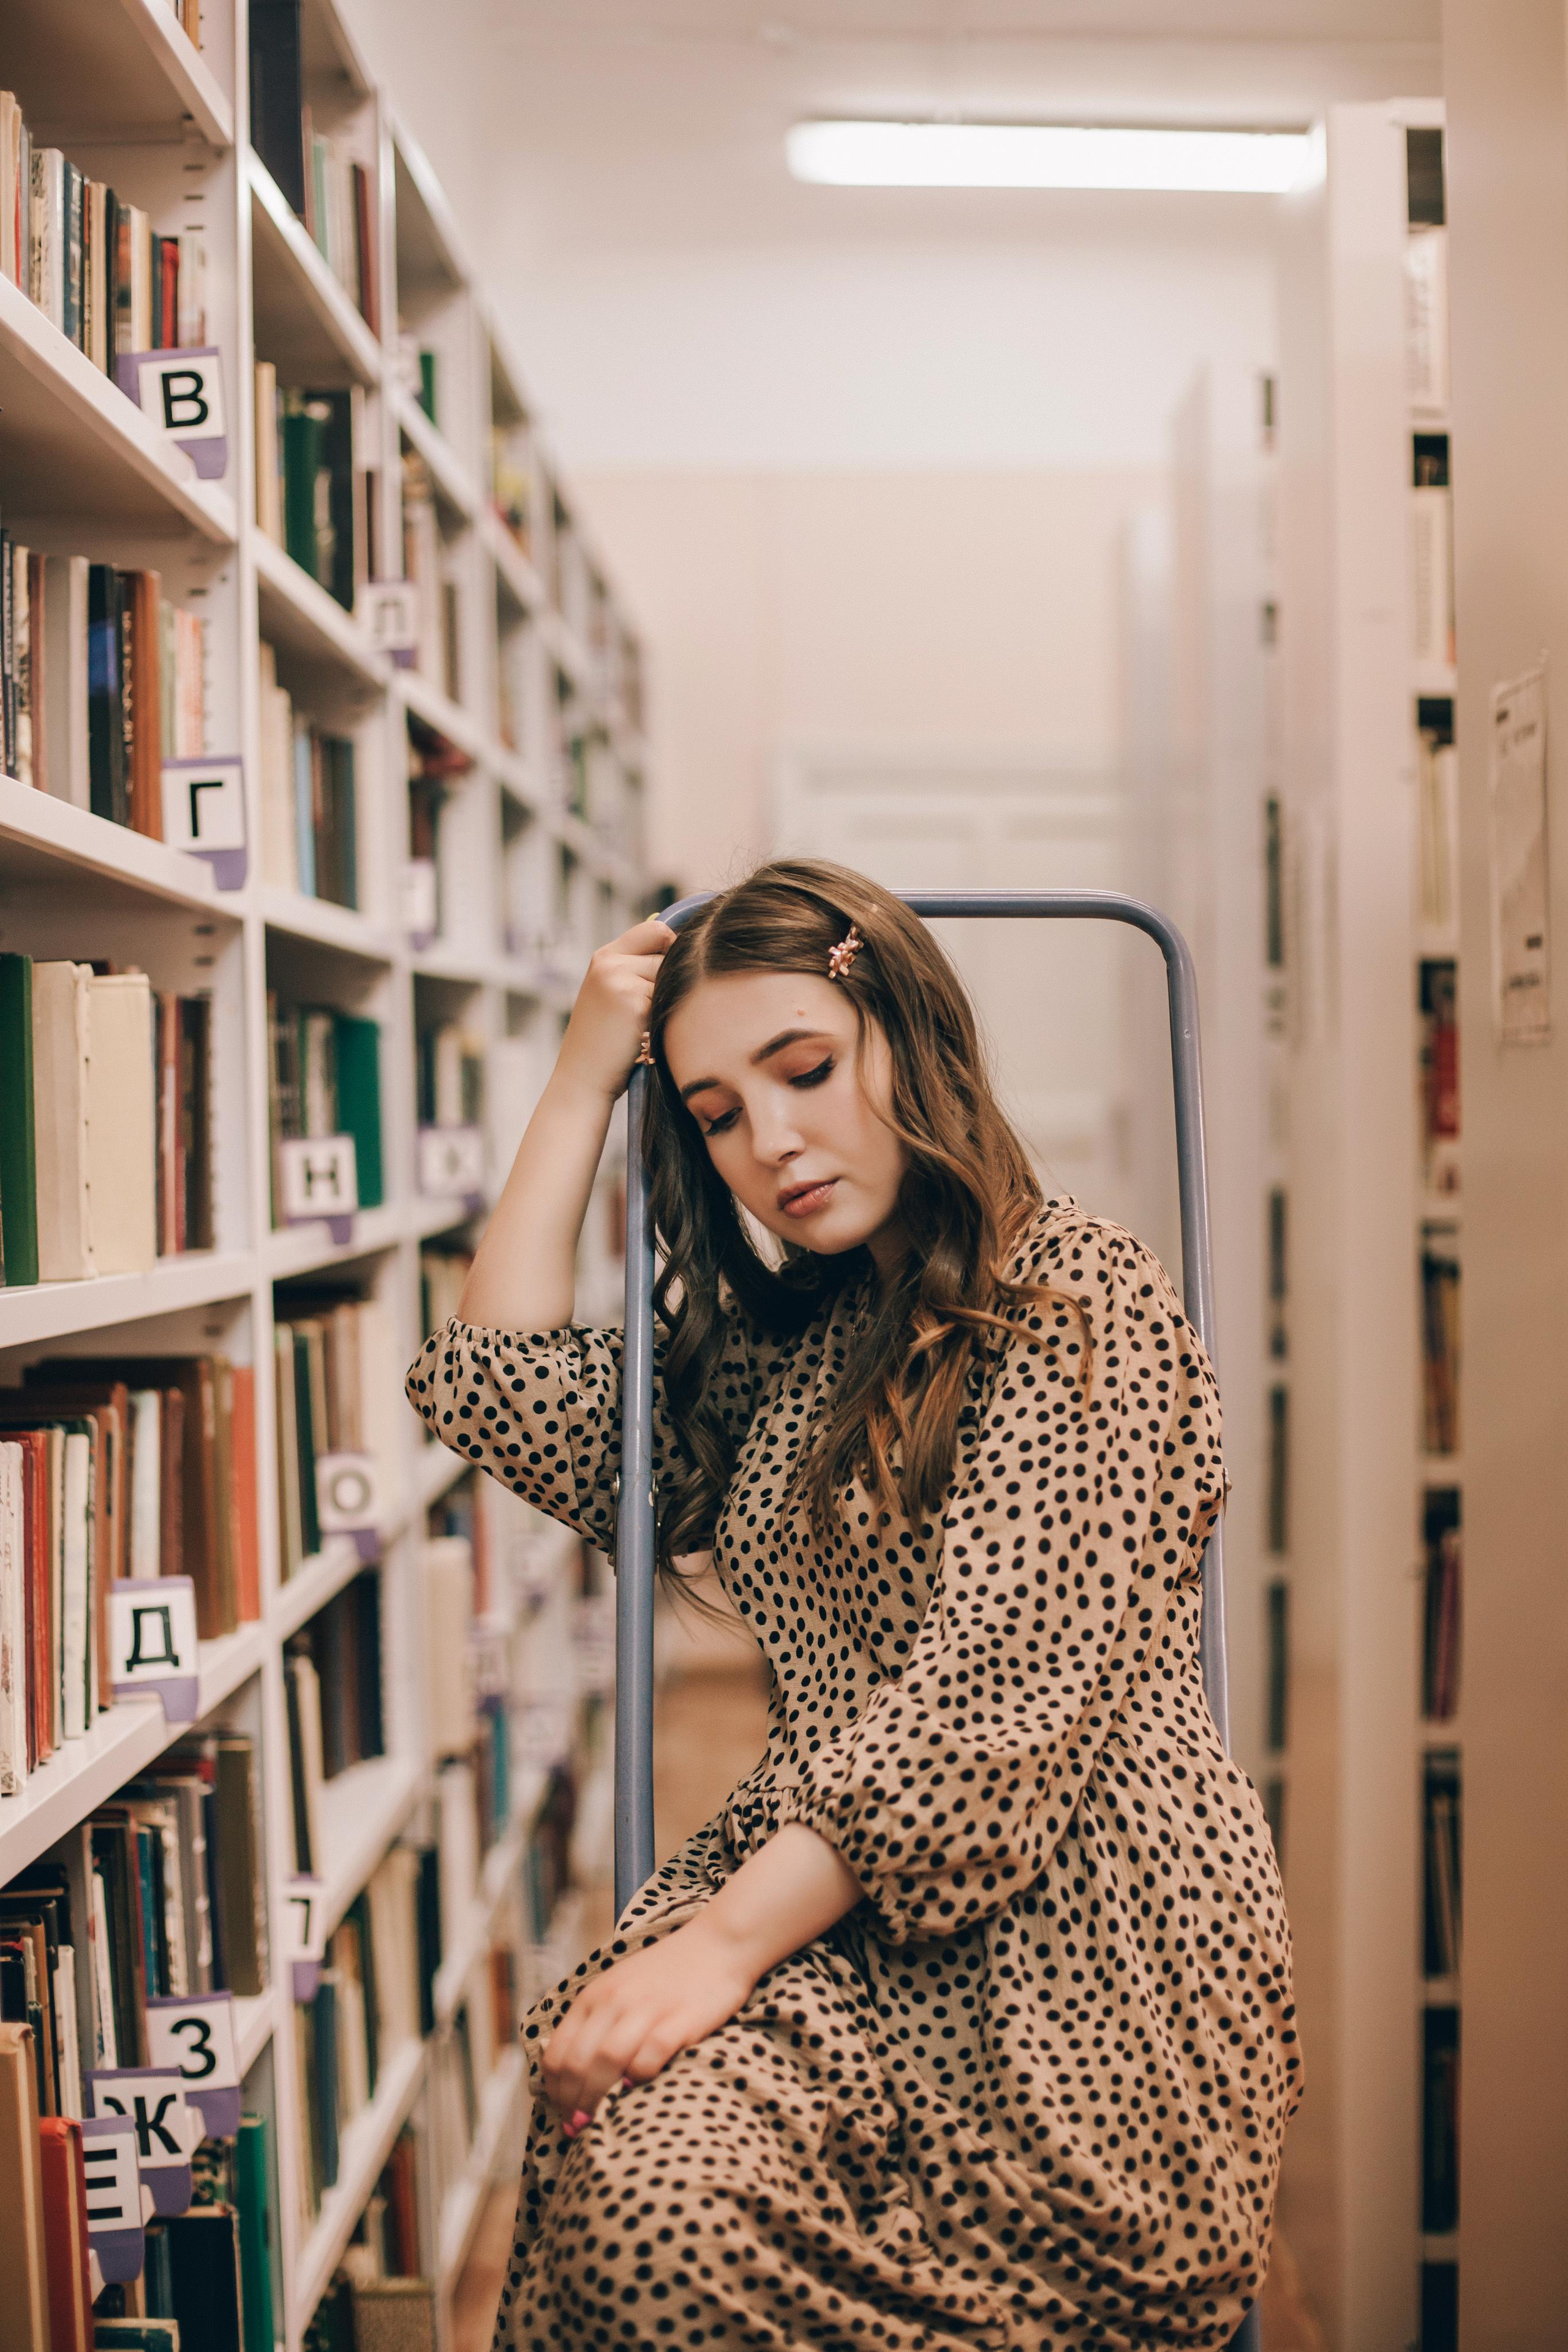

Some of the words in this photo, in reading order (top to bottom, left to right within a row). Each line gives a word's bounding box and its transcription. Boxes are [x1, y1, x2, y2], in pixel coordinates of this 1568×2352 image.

[160, 370, 208, 429] В
[189, 781, 223, 837] Г
[303, 1156, 341, 1198] Н
[328, 1470, 371, 1514] О
[126, 1606, 179, 1672] Д
